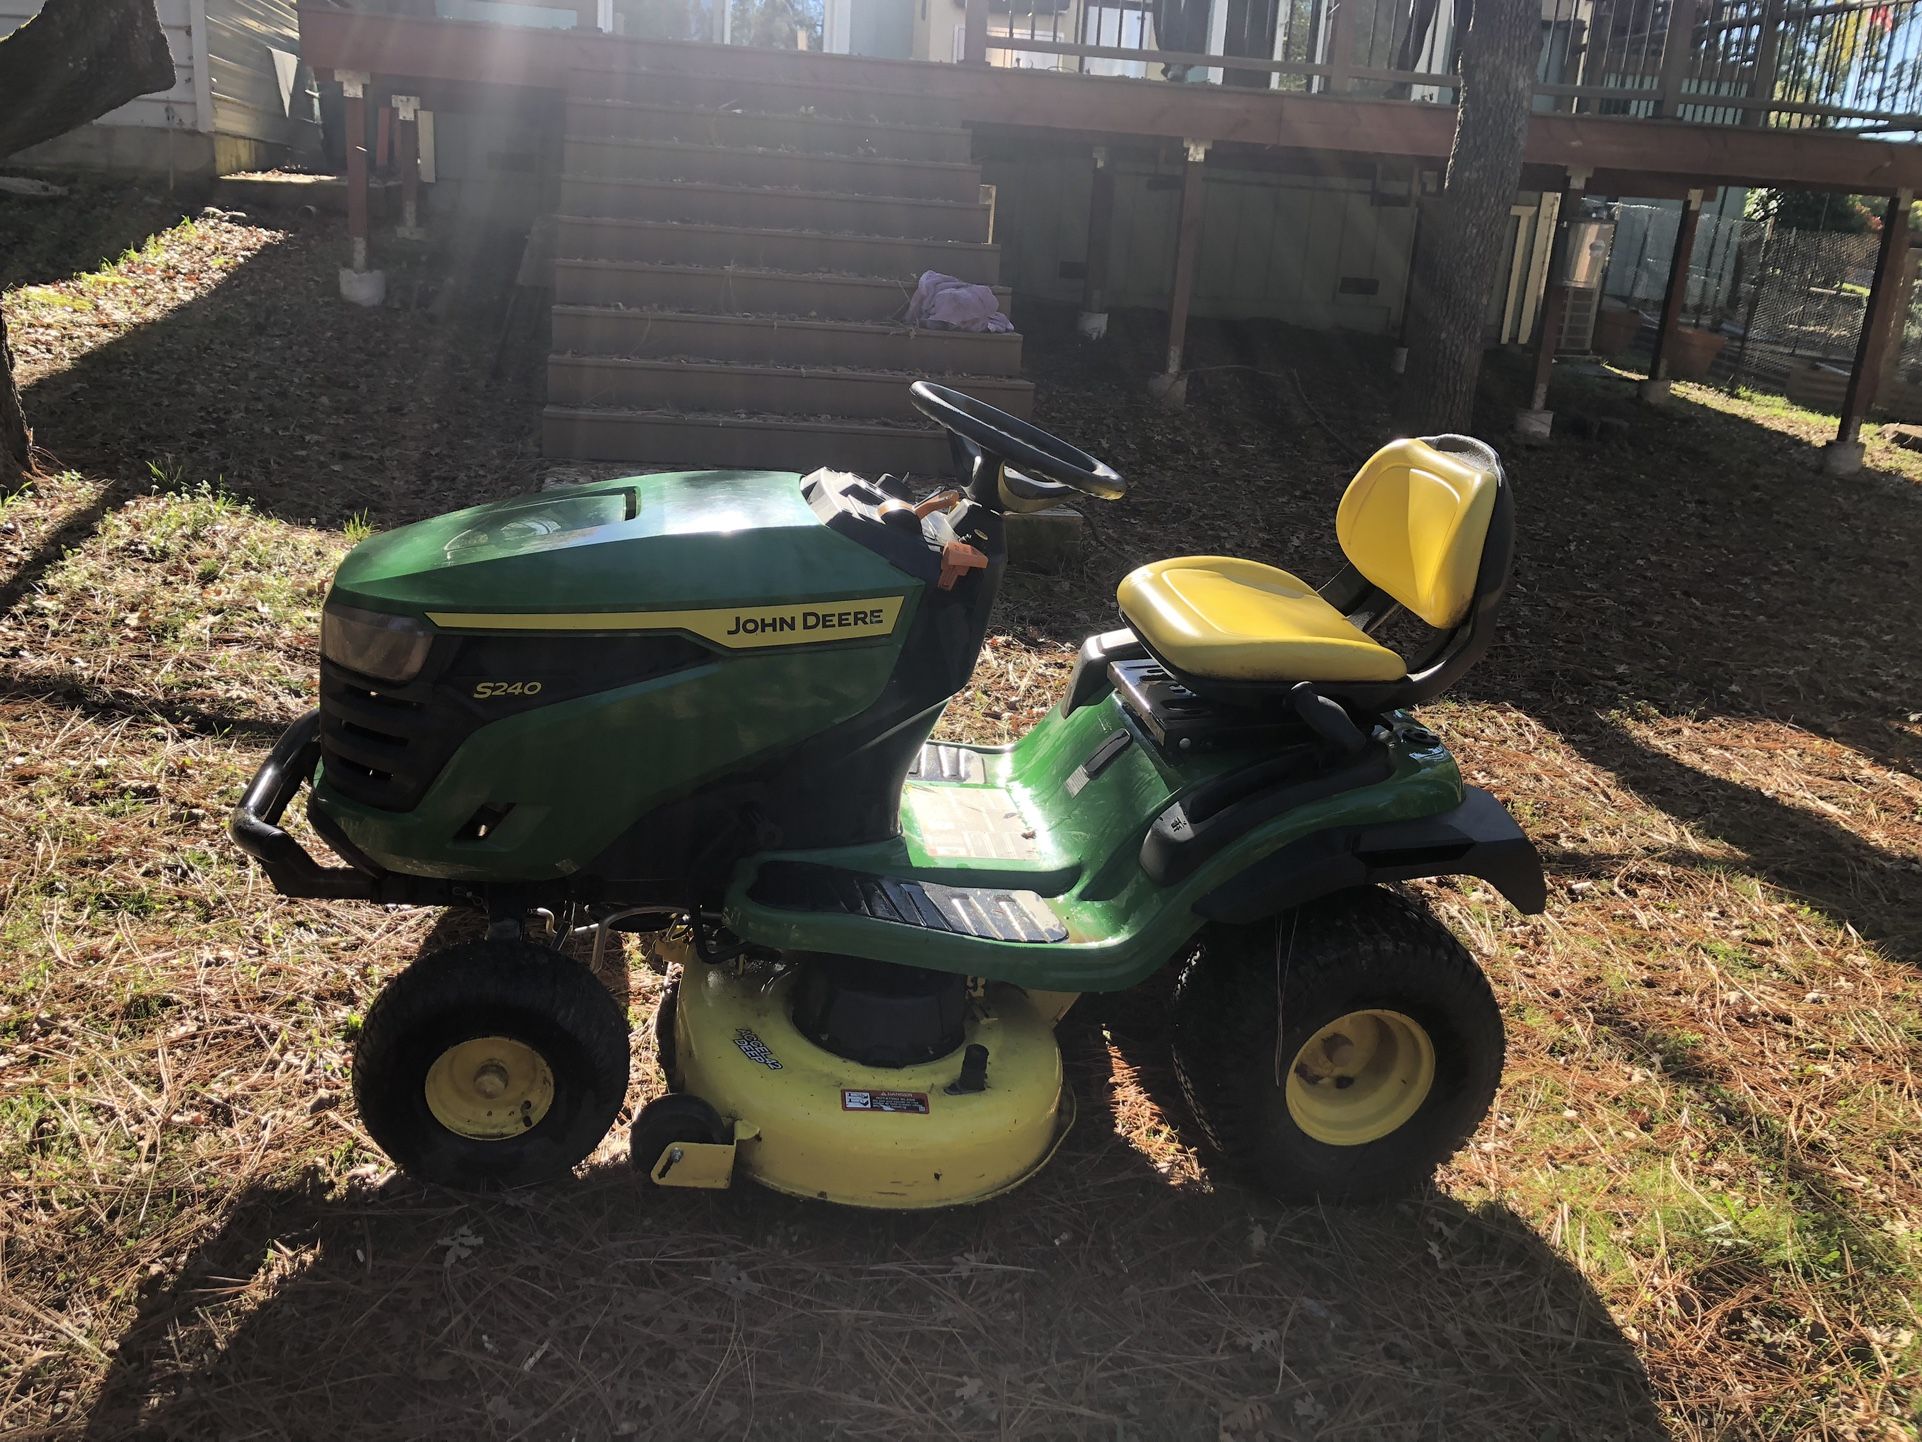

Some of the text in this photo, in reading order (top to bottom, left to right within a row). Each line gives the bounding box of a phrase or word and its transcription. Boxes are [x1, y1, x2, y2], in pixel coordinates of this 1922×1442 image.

[727, 609, 884, 635] JOHN DEERE
[473, 681, 542, 699] S240
[733, 1039, 766, 1063] DEEP
